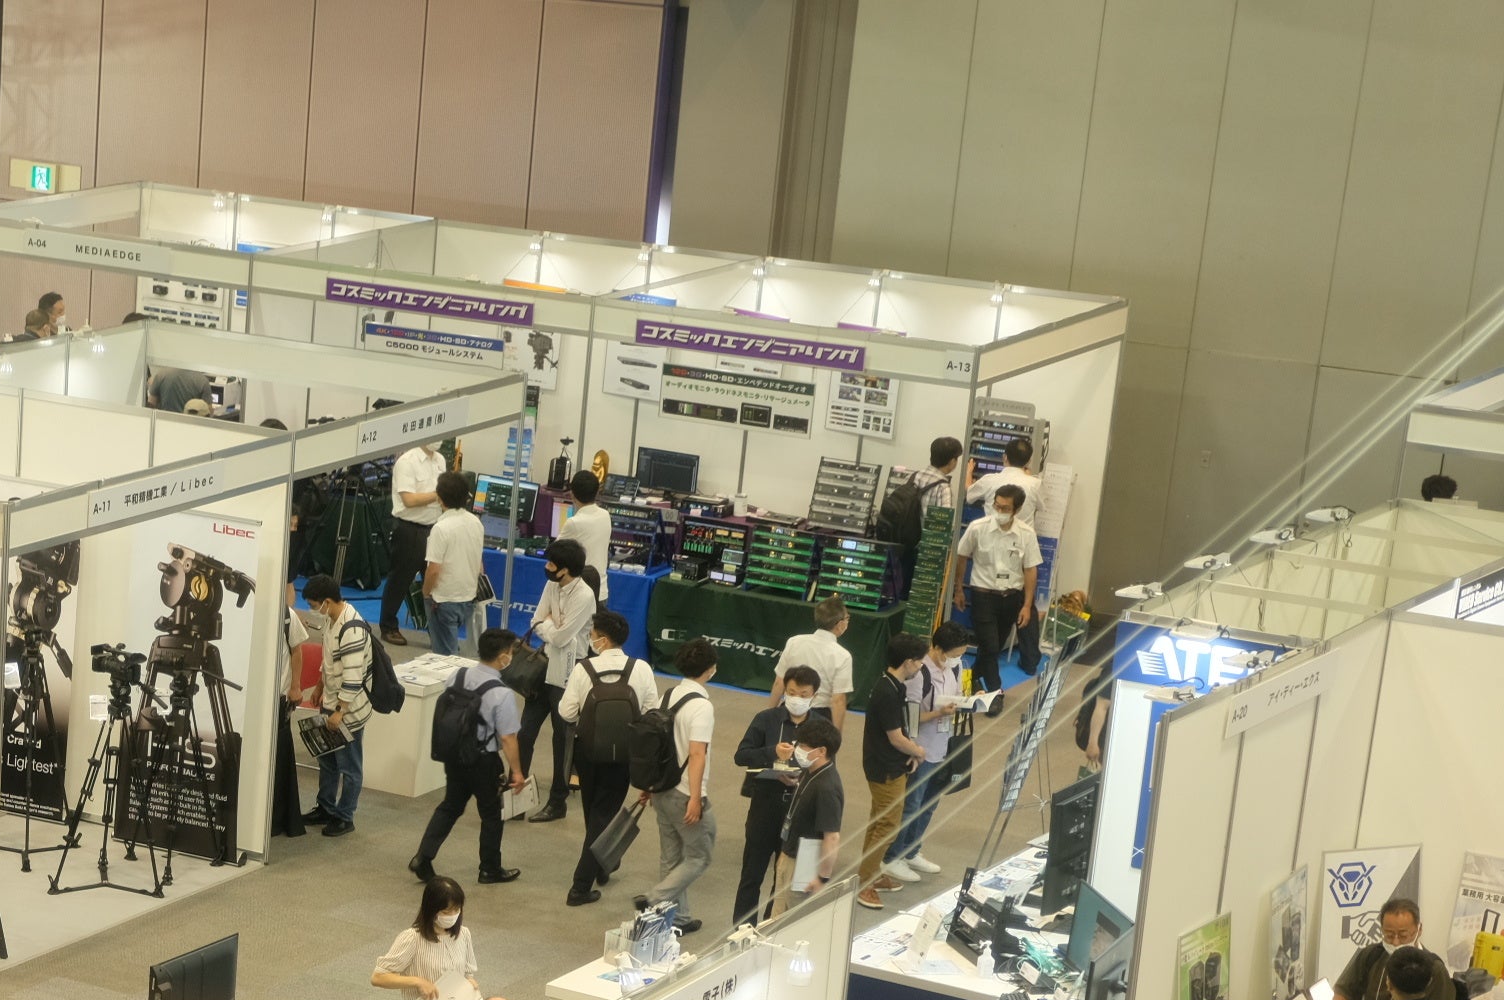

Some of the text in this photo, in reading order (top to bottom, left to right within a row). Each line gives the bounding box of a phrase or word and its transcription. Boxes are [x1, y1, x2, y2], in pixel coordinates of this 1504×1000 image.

[27, 237, 47, 249] A-04
[75, 244, 142, 262] MEDIAEDGE
[330, 283, 529, 320] コスミックエンジニアリング
[641, 325, 860, 364] コスミックエンジニアリング
[946, 360, 972, 373] A-13
[361, 430, 378, 445] A-12
[92, 499, 112, 516] A-11
[213, 521, 256, 540] Libec
[1136, 636, 1268, 690] ATE
[1231, 704, 1248, 724] A-20
